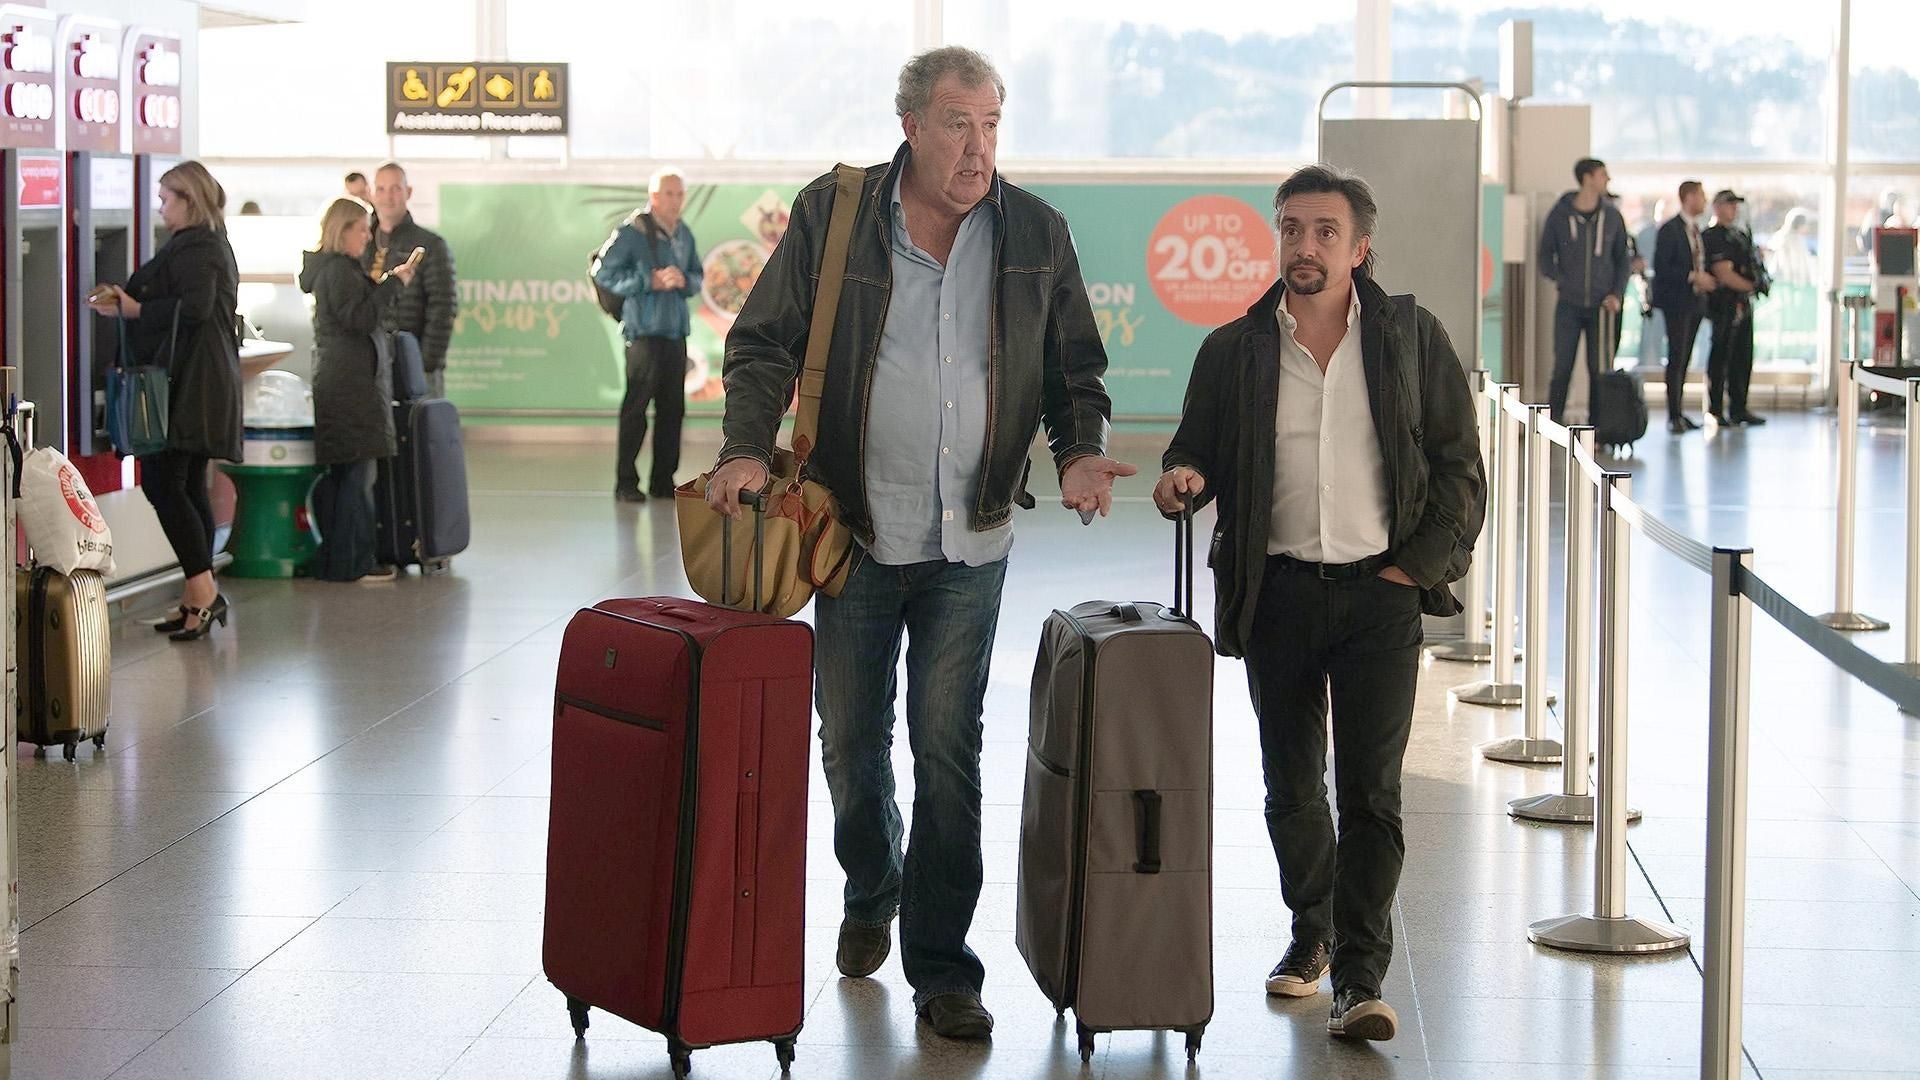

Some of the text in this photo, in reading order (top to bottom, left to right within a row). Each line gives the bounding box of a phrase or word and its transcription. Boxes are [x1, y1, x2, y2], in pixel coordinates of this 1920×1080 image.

[393, 111, 562, 133] Assistance Reception
[1183, 213, 1243, 233] UP TO
[1227, 260, 1271, 280] OFF
[455, 279, 596, 303] TINATION
